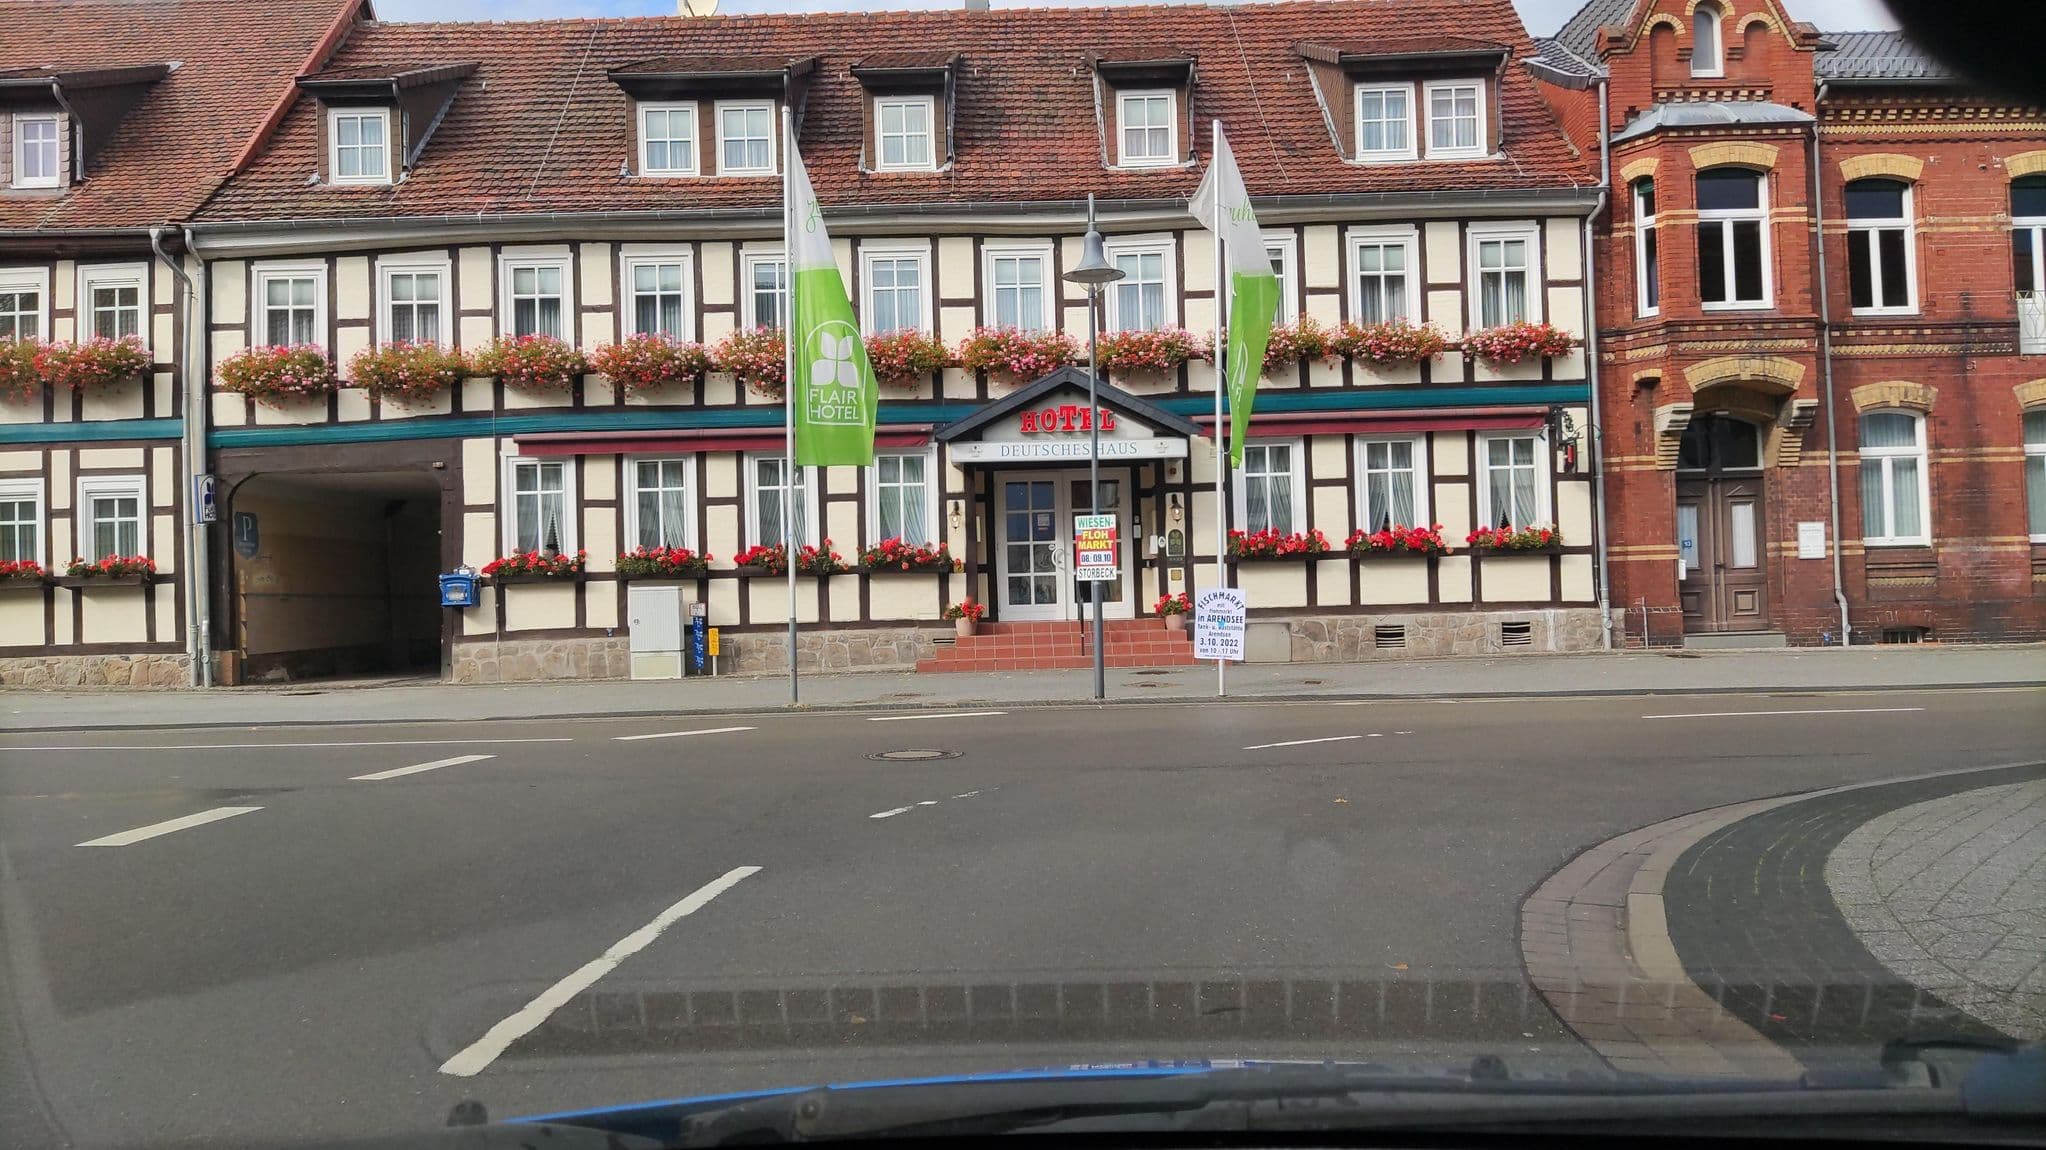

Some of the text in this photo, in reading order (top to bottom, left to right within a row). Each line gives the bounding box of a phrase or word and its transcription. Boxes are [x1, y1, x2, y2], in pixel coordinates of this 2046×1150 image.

[810, 388, 857, 404] FLAIR
[810, 404, 859, 419] HOTEL
[1020, 405, 1116, 432] HOTEL
[1001, 442, 1138, 457] DEUTSCHES HAUS
[242, 515, 252, 541] P
[1077, 516, 1114, 528] WIESEN-
[1082, 530, 1109, 540] FLOH
[1078, 540, 1113, 550] MARKT
[1078, 567, 1115, 579] STORBECK
[1197, 592, 1245, 610] FISCHMARKT
[1207, 614, 1244, 624] ARENDSEE
[1220, 638, 1239, 647] 2022
